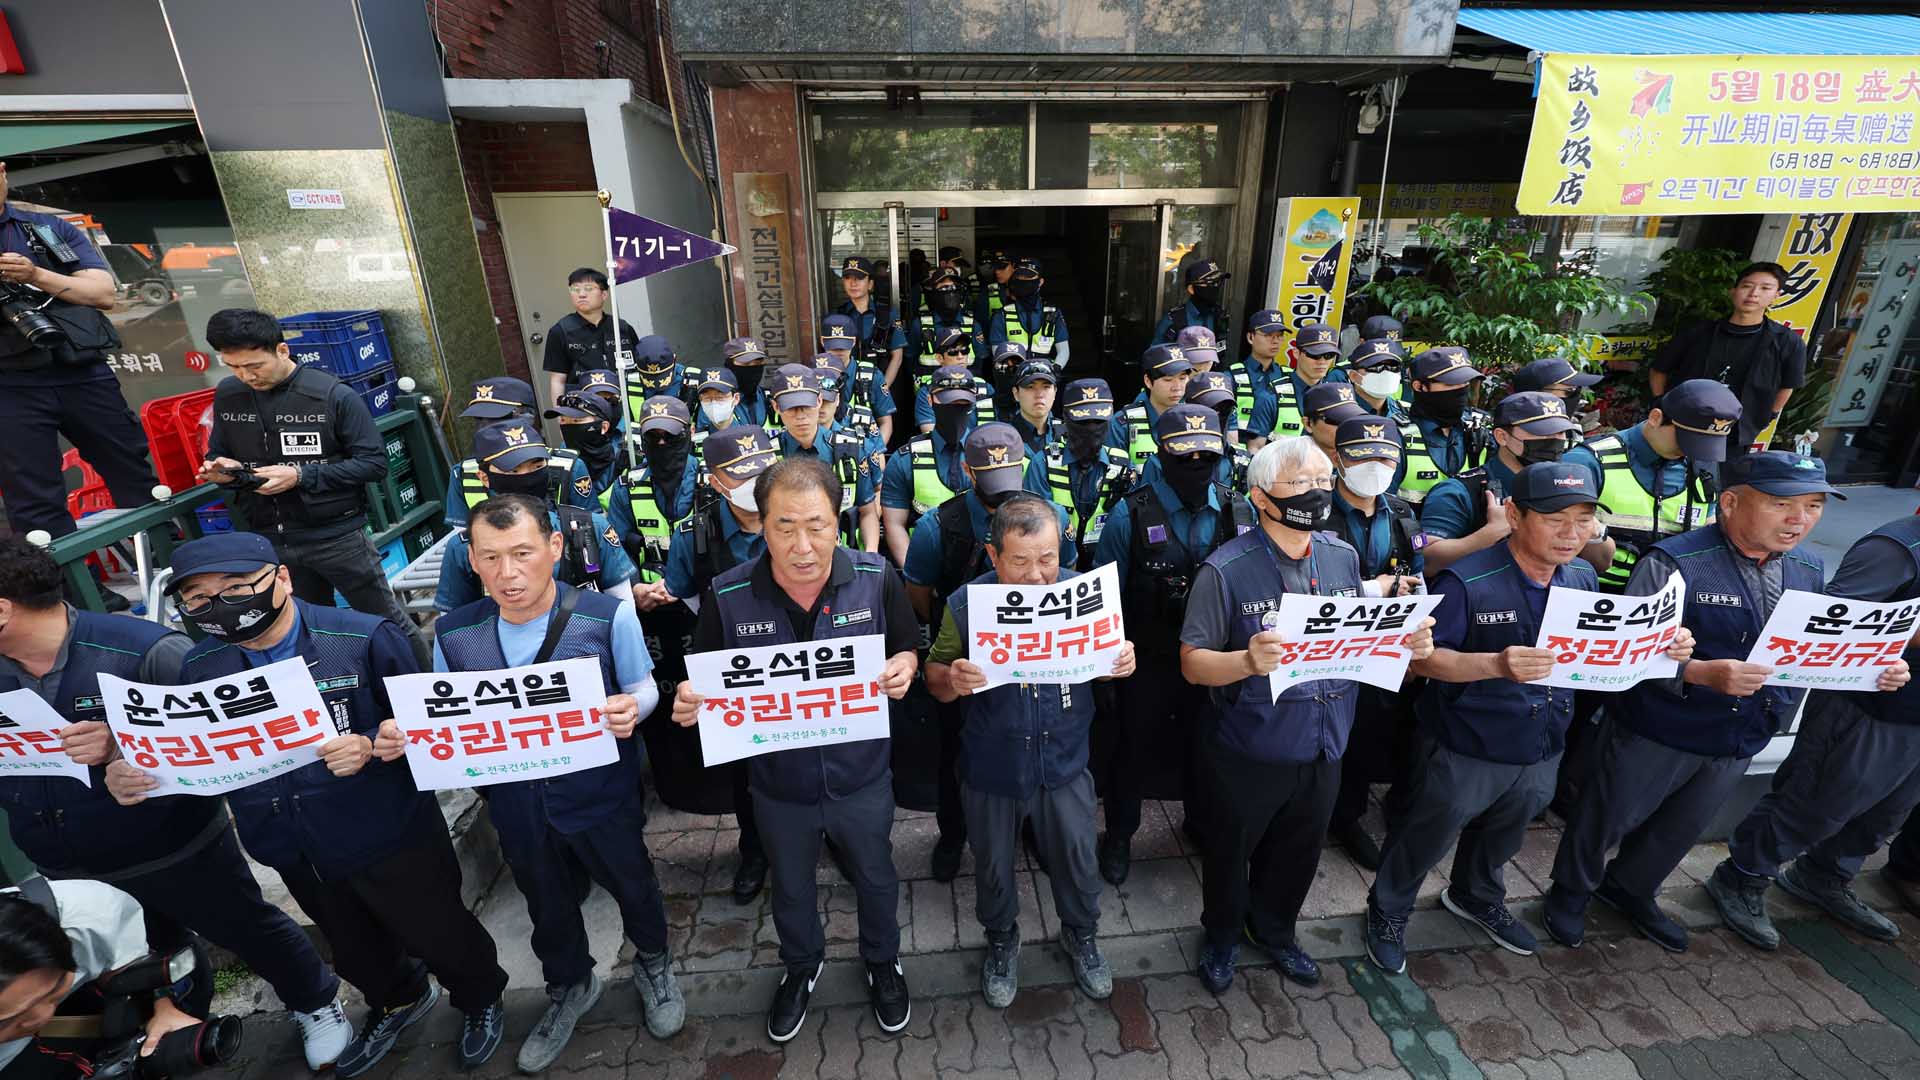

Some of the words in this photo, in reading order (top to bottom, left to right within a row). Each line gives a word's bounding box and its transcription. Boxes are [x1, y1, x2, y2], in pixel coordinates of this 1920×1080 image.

[1709, 70, 1761, 103] 5월
[1773, 71, 1841, 103] 18일
[1550, 65, 1599, 205] 故乡饭店
[1681, 113, 1913, 146] 开业期间每桌赠送
[1769, 152, 1833, 170] (5月18日
[1658, 178, 1748, 201] 오픈기간
[1756, 177, 1839, 200] 테이블당
[615, 236, 691, 260] 71기-1
[359, 342, 375, 360] Cass
[374, 390, 389, 409] Cass
[221, 412, 257, 423] OLICE
[275, 414, 327, 423] POLICE
[997, 577, 1104, 624] 윤석열
[1576, 586, 1676, 631] 윤석열
[1304, 602, 1418, 634] 윤석열
[1804, 604, 1920, 635] 윤석열
[976, 613, 1120, 665] 정권규탄
[721, 645, 855, 689] 윤석열
[123, 676, 278, 727] 윤석열
[424, 671, 571, 718] 윤석열
[704, 681, 881, 727] 정권규탄
[116, 708, 325, 768] 정권규탄
[406, 707, 603, 760] 정권규탄
[771, 727, 848, 742] 전국건설노동조합
[487, 756, 573, 774] 전국건설노동조합
